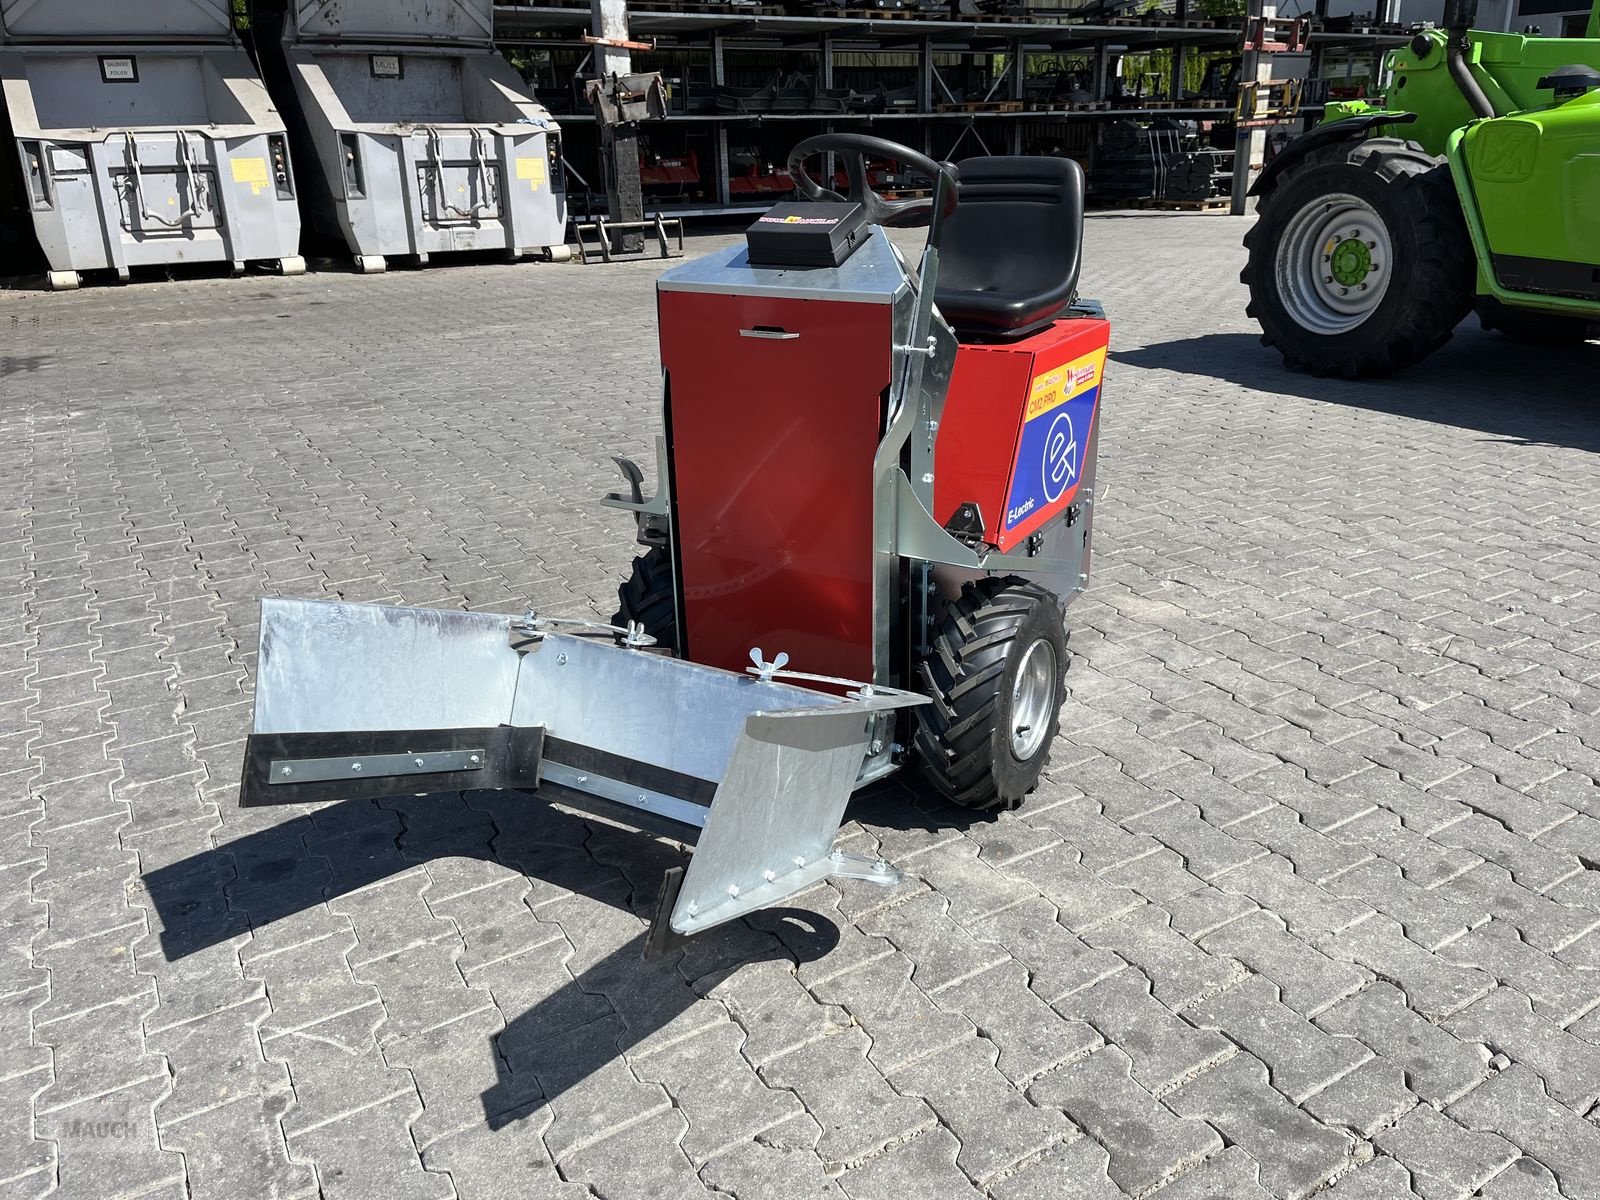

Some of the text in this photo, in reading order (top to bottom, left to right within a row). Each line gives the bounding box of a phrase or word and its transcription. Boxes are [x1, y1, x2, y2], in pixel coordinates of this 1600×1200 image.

[1029, 390, 1056, 414] CM2 PRO
[1008, 497, 1034, 524] E-Lectric
